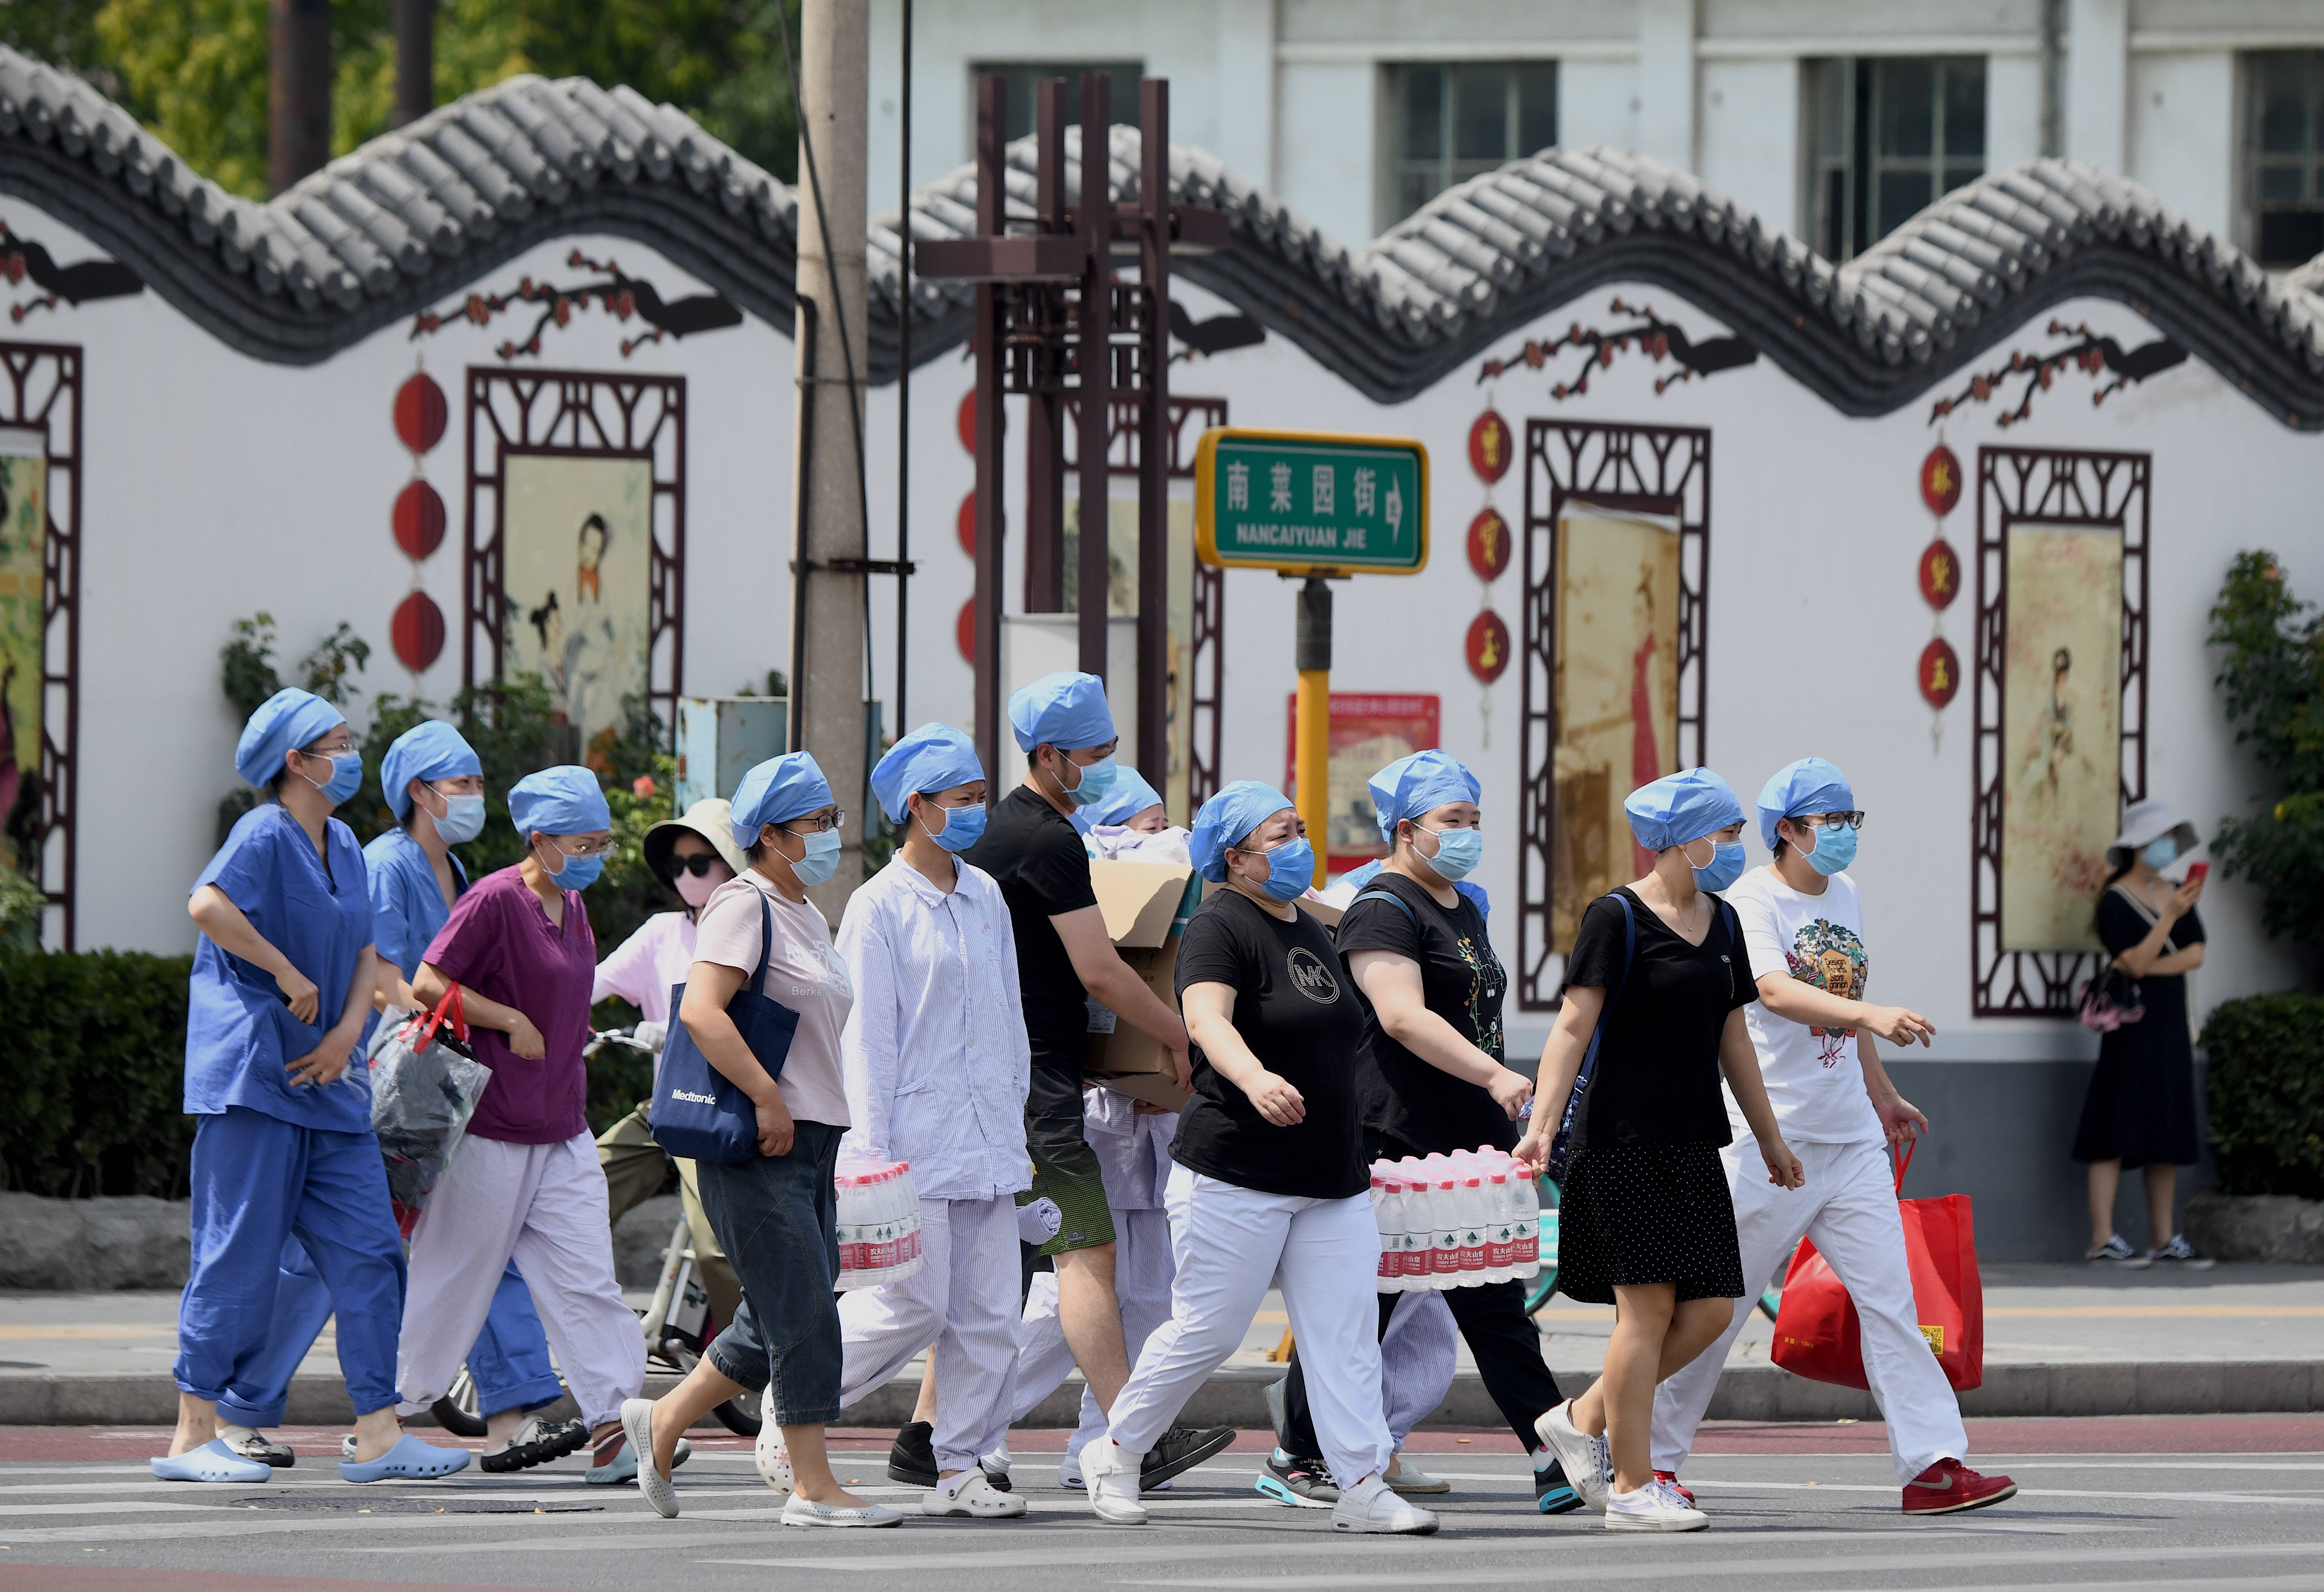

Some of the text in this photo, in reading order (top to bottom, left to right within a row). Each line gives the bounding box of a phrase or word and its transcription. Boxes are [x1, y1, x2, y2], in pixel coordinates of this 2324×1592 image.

[1227, 460, 1376, 516] 南菜园街
[1237, 523, 1367, 549] NANCAIYUAN JIE
[1825, 958, 1847, 966] Design
[1294, 964, 1334, 987] MK
[1830, 974, 1845, 982] Store
[792, 986, 829, 997] Berkele
[671, 1089, 716, 1105] Medtronic
